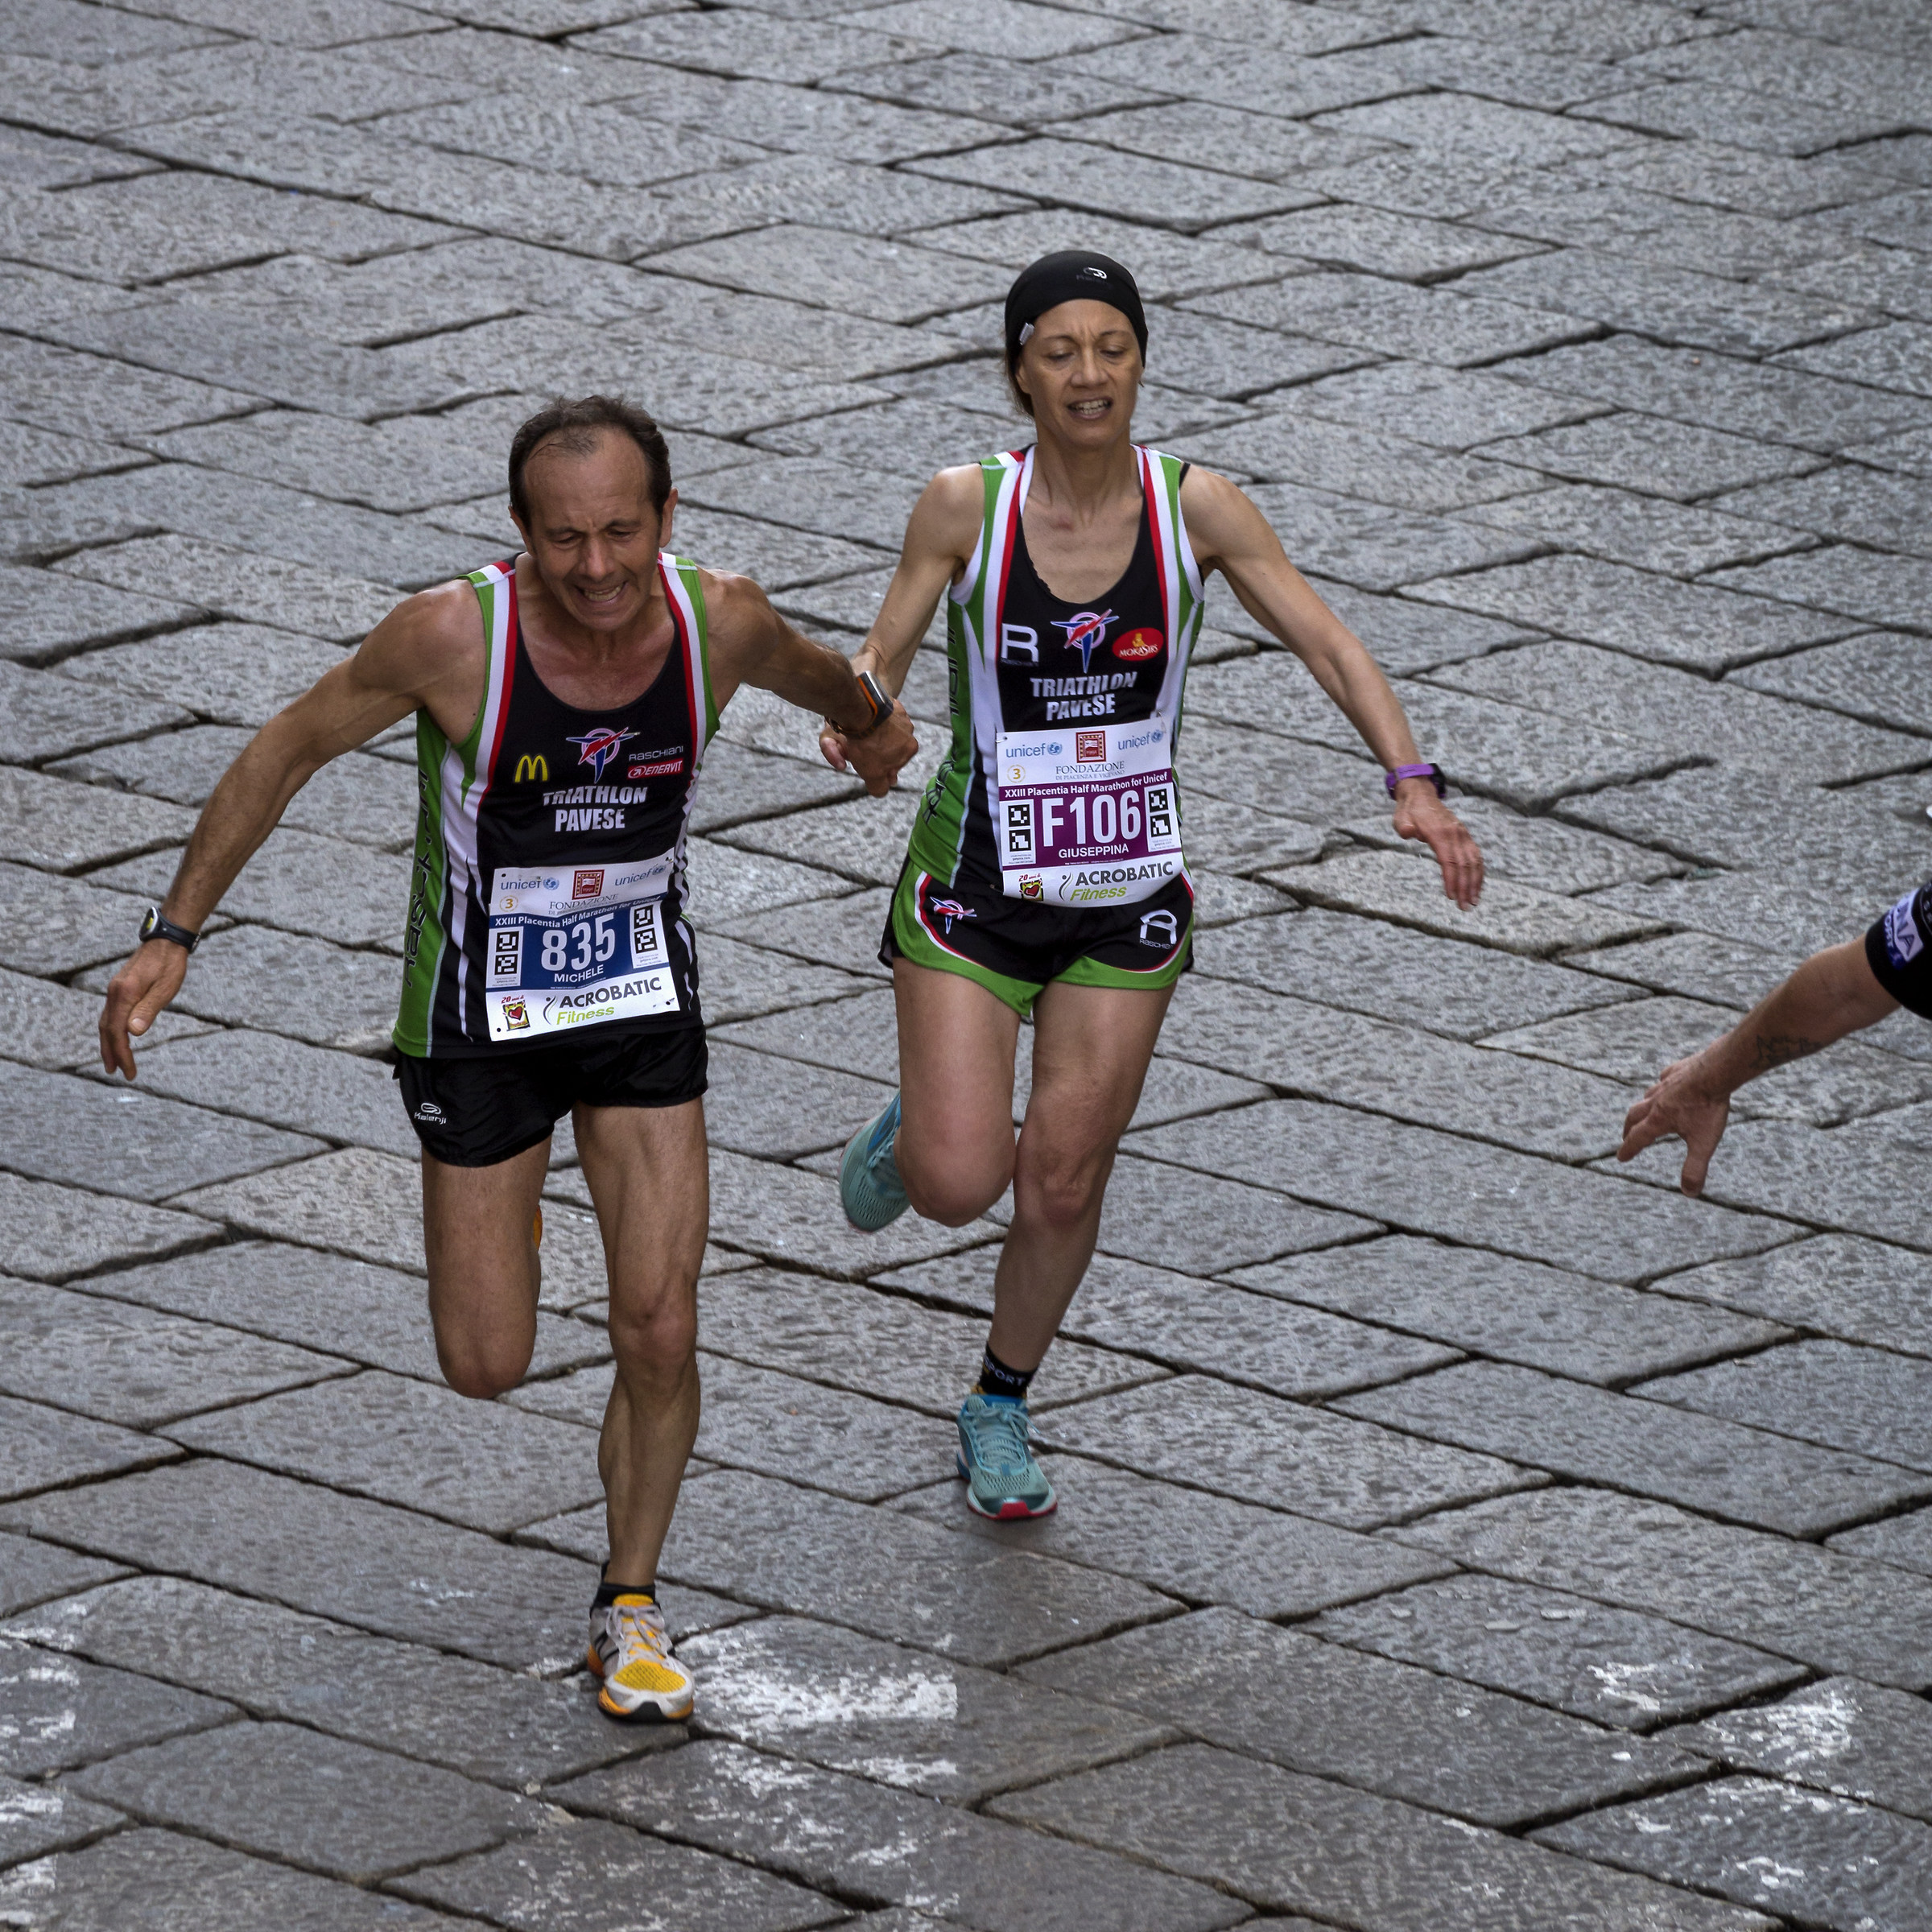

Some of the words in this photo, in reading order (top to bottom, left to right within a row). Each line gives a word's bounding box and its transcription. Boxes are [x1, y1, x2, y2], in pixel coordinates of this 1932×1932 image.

[1030, 671, 1137, 697] TRIATHLON
[1046, 693, 1116, 721] PAVESE
[1117, 731, 1151, 750] unicef
[1005, 743, 1046, 758] unicef
[645, 760, 683, 775] ENERVIT
[1013, 768, 1022, 780] 3
[1055, 761, 1125, 774] FONDAZIONE
[1005, 789, 1026, 798] XXIII
[1027, 786, 1069, 796] Placentia
[1071, 784, 1090, 795] Half
[1091, 781, 1130, 793] Marathon
[1131, 778, 1142, 786] for
[1143, 771, 1167, 784] Unicef
[543, 786, 648, 806] TRIATHLON
[555, 807, 625, 832] PAVESE
[1042, 790, 1141, 847] F106
[1058, 843, 1129, 858] GIUSEPPINA
[614, 868, 652, 886] unicef
[1075, 861, 1174, 886] ACROBATIC
[501, 879, 542, 890] unicef
[1070, 886, 1127, 901] Fitness
[505, 898, 514, 909] 3
[549, 894, 618, 910] FONDAZIONE
[495, 917, 516, 926] XXIII
[518, 916, 560, 928] Placentia
[562, 915, 577, 927] Half
[579, 906, 617, 920] Marathon
[541, 913, 616, 971] 835
[554, 964, 604, 983] MICHELE
[502, 996, 511, 1004] 20
[559, 977, 662, 1009] ACROBATIC
[556, 1006, 615, 1025] Fitness
